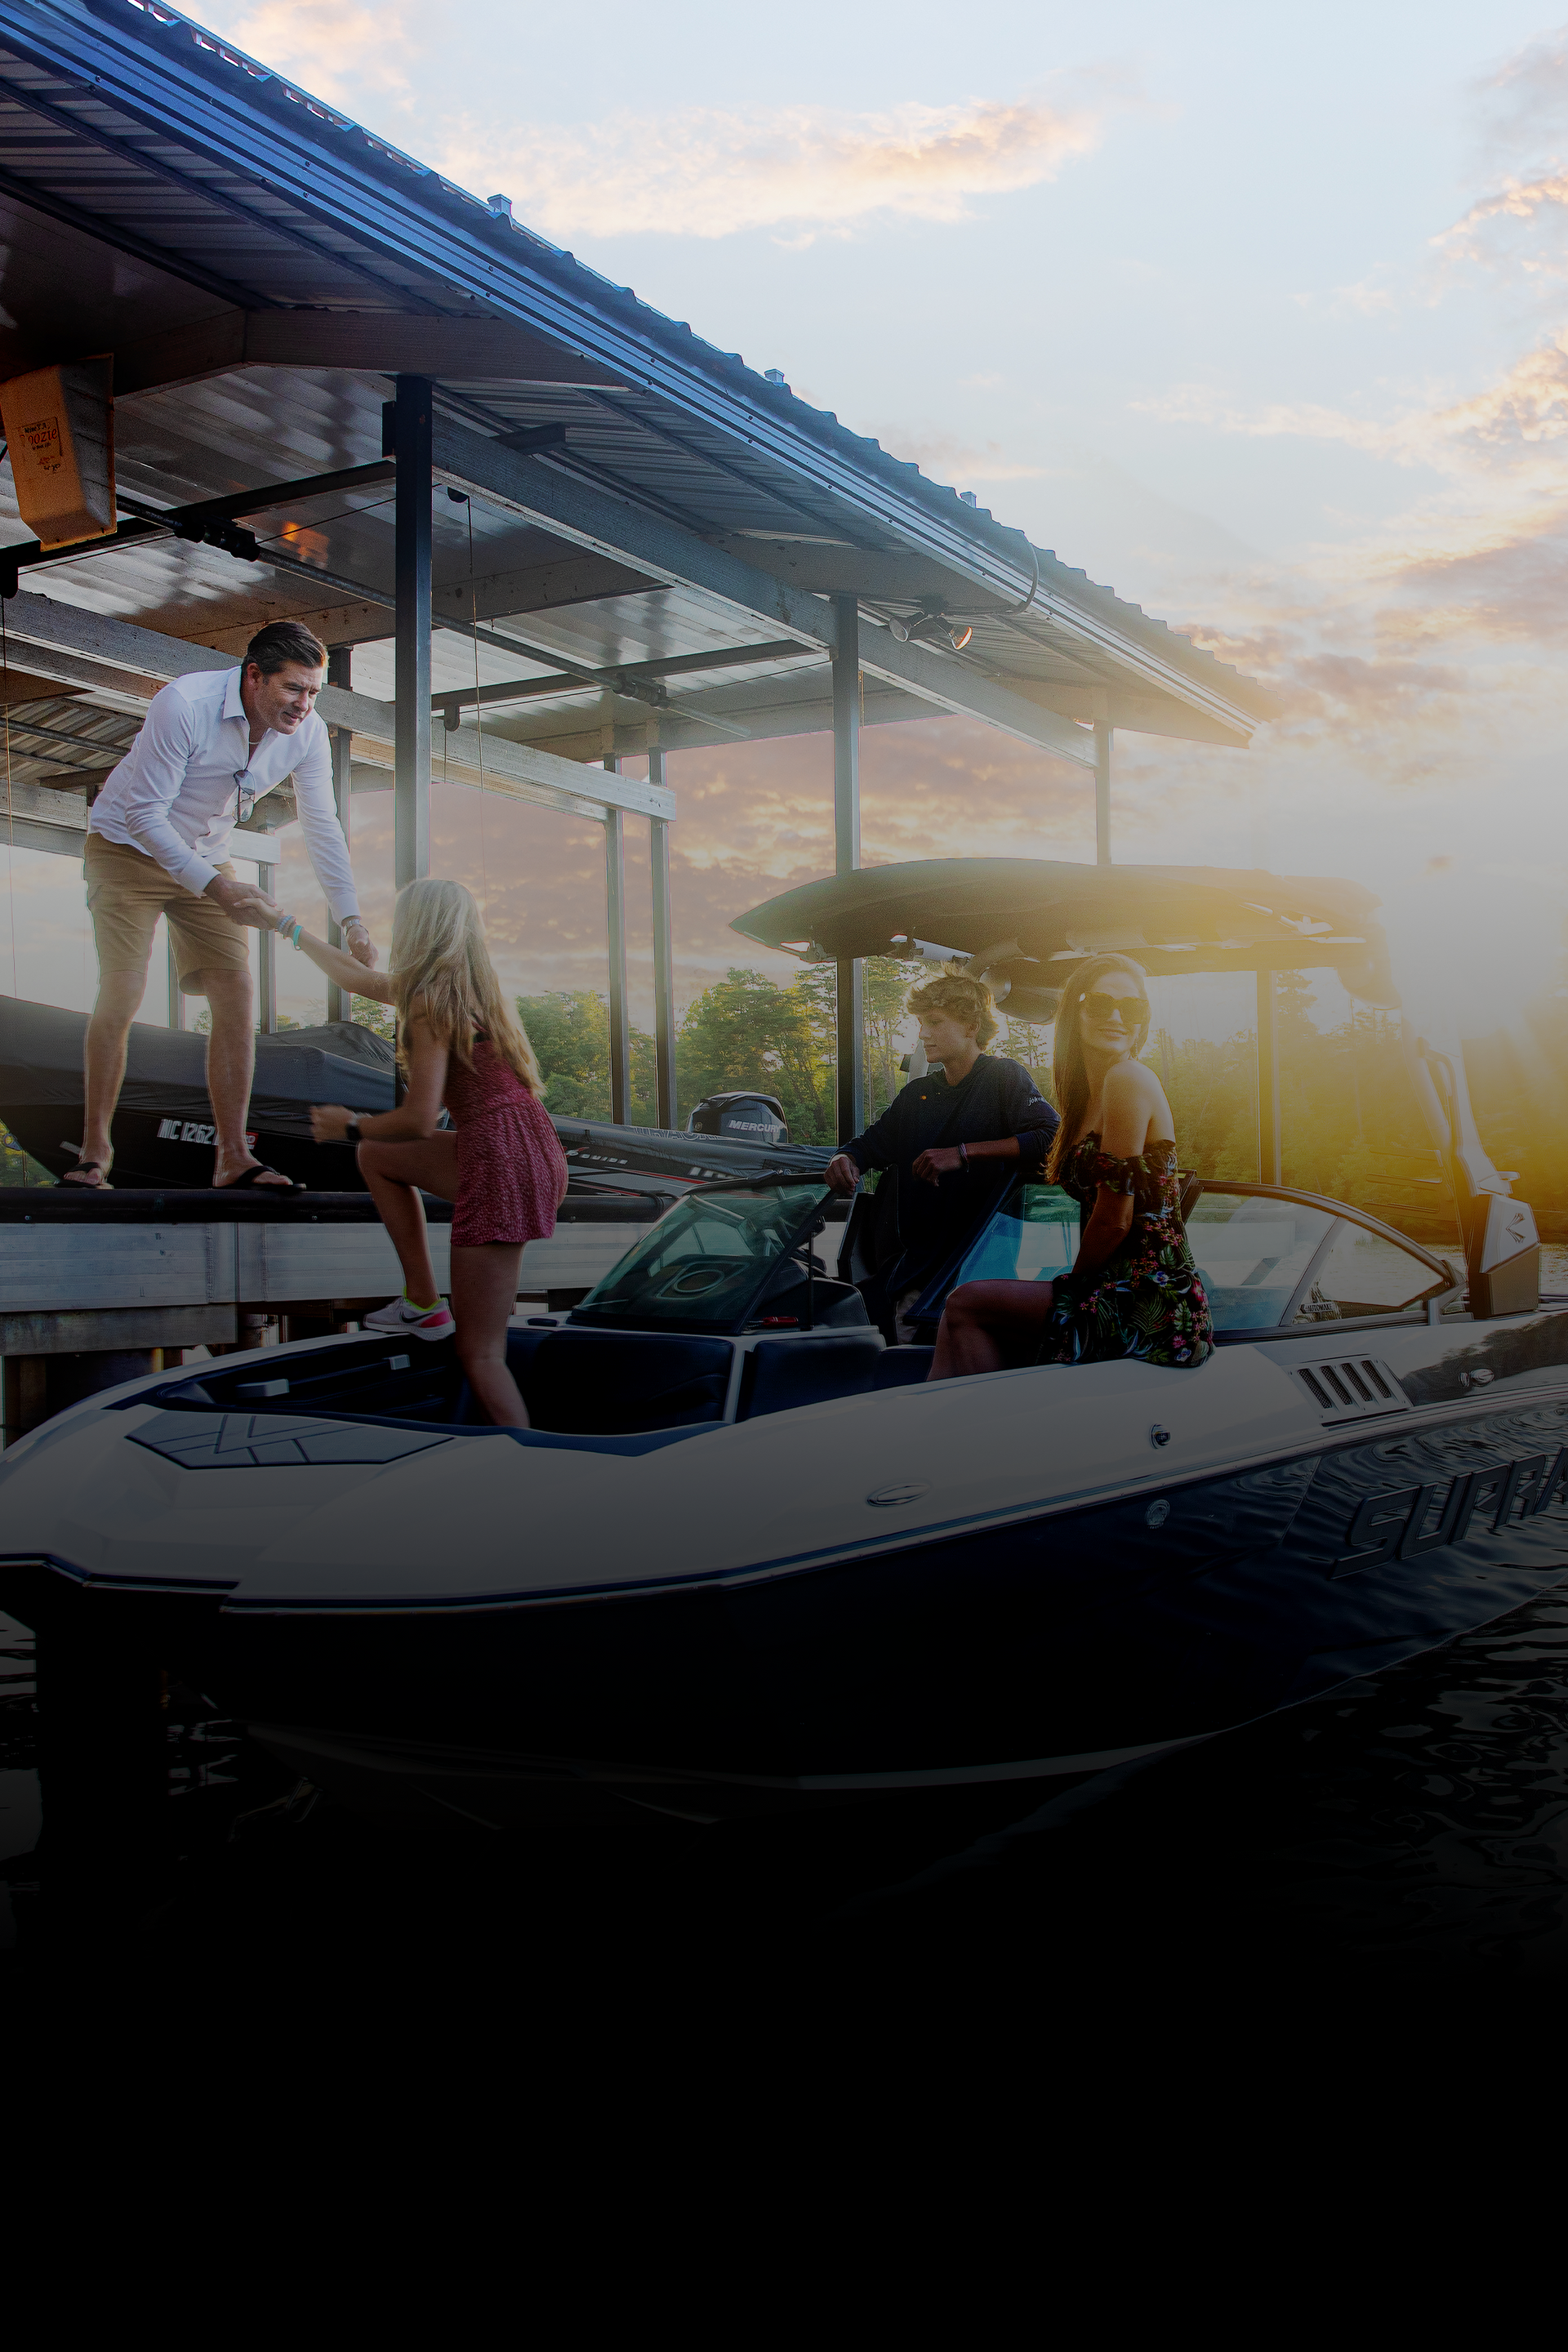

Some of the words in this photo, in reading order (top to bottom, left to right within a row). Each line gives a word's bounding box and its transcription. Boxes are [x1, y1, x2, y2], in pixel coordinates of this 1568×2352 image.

[19, 428, 58, 447] oozie
[157, 1118, 182, 1140] NC
[180, 1121, 216, 1144] 1262
[728, 1119, 782, 1133] MERCURY
[580, 1153, 629, 1165] GUIDE
[1326, 1445, 1568, 1581] SUPRA
